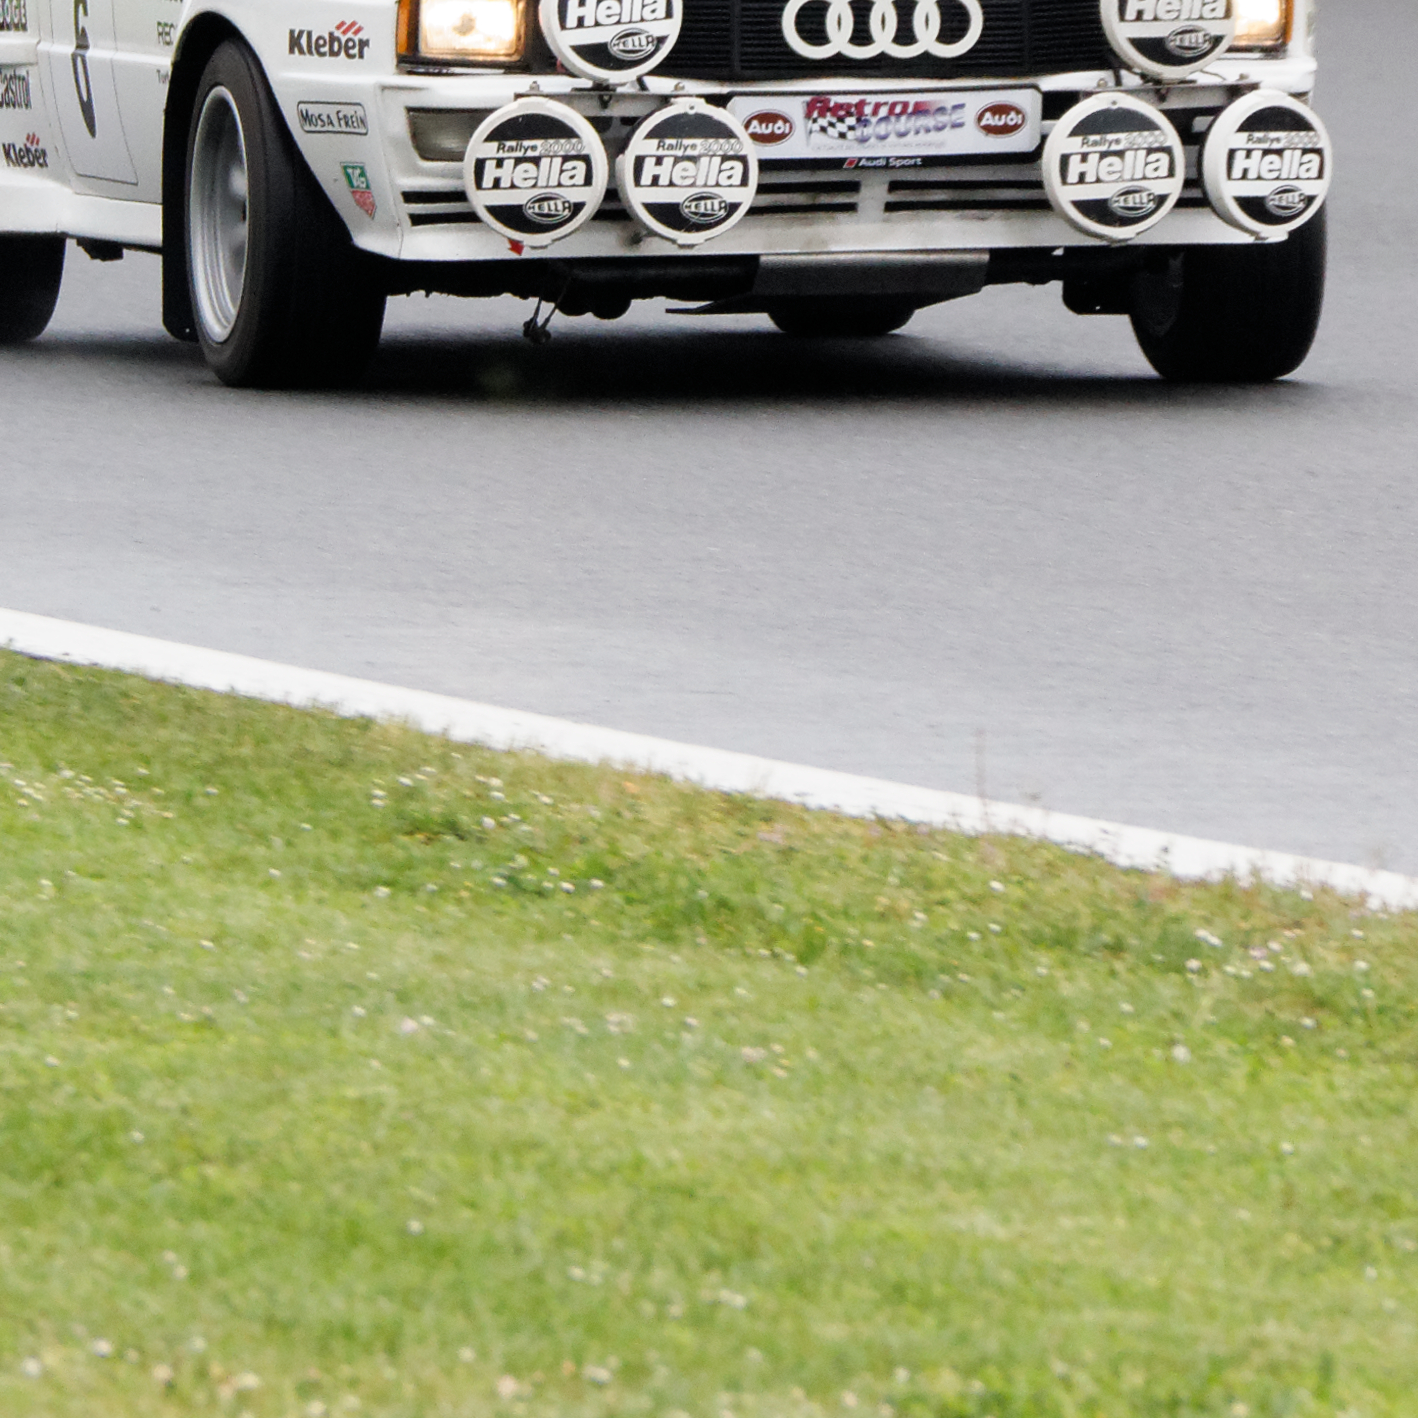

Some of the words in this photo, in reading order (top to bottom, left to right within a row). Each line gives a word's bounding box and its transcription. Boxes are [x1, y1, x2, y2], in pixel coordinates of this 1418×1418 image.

[288, 28, 370, 59] Kleber
[612, 34, 656, 49] HELLA
[804, 96, 910, 119] Retro
[746, 118, 791, 136] Audi
[855, 102, 966, 143] COURSE
[979, 110, 1025, 128] Audi
[496, 141, 539, 156] Rallye
[539, 138, 586, 155] 2000
[655, 140, 699, 155] Rallye
[699, 139, 744, 155] 2000
[1080, 135, 1123, 150] Rallye
[1123, 131, 1168, 149] 2000
[1245, 133, 1282, 148] Rallye
[1282, 132, 1322, 148] 2000
[2, 142, 49, 168] Kleber
[858, 158, 887, 168] Audi
[888, 156, 923, 169] Sport
[481, 156, 587, 189] Hella
[639, 155, 744, 187] Hella
[1066, 149, 1170, 184] Hella
[1230, 149, 1322, 180] Hella
[527, 201, 574, 214] HELLA
[683, 199, 729, 213] HELLA
